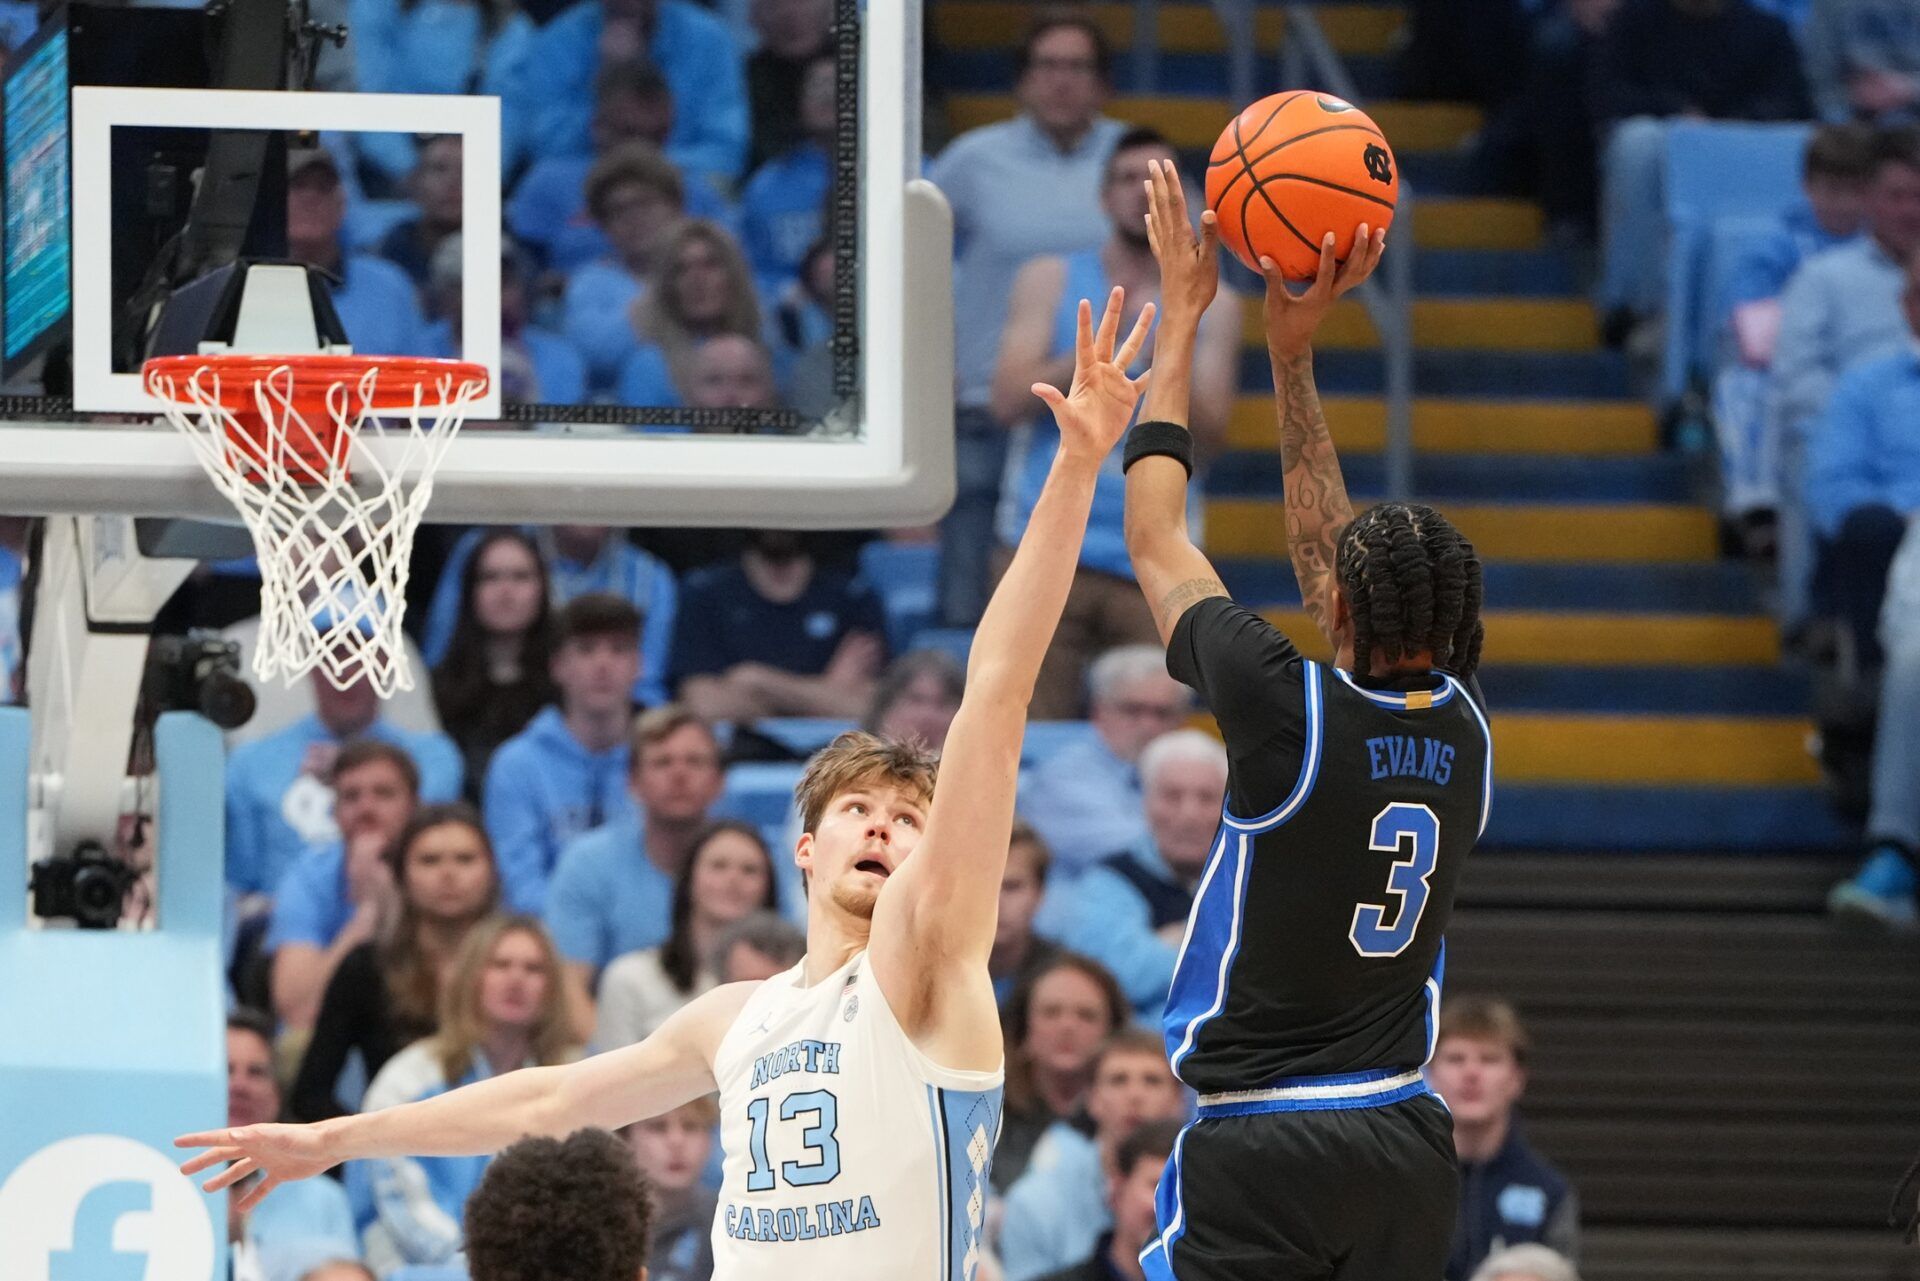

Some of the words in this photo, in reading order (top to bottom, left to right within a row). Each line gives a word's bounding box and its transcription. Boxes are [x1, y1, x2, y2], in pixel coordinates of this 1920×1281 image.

[1366, 735, 1455, 786] EVANS
[1348, 802, 1441, 958] 3
[750, 1039, 841, 1091] NORTH
[747, 1088, 841, 1192] 13
[725, 1195, 881, 1242] CAROLINA
